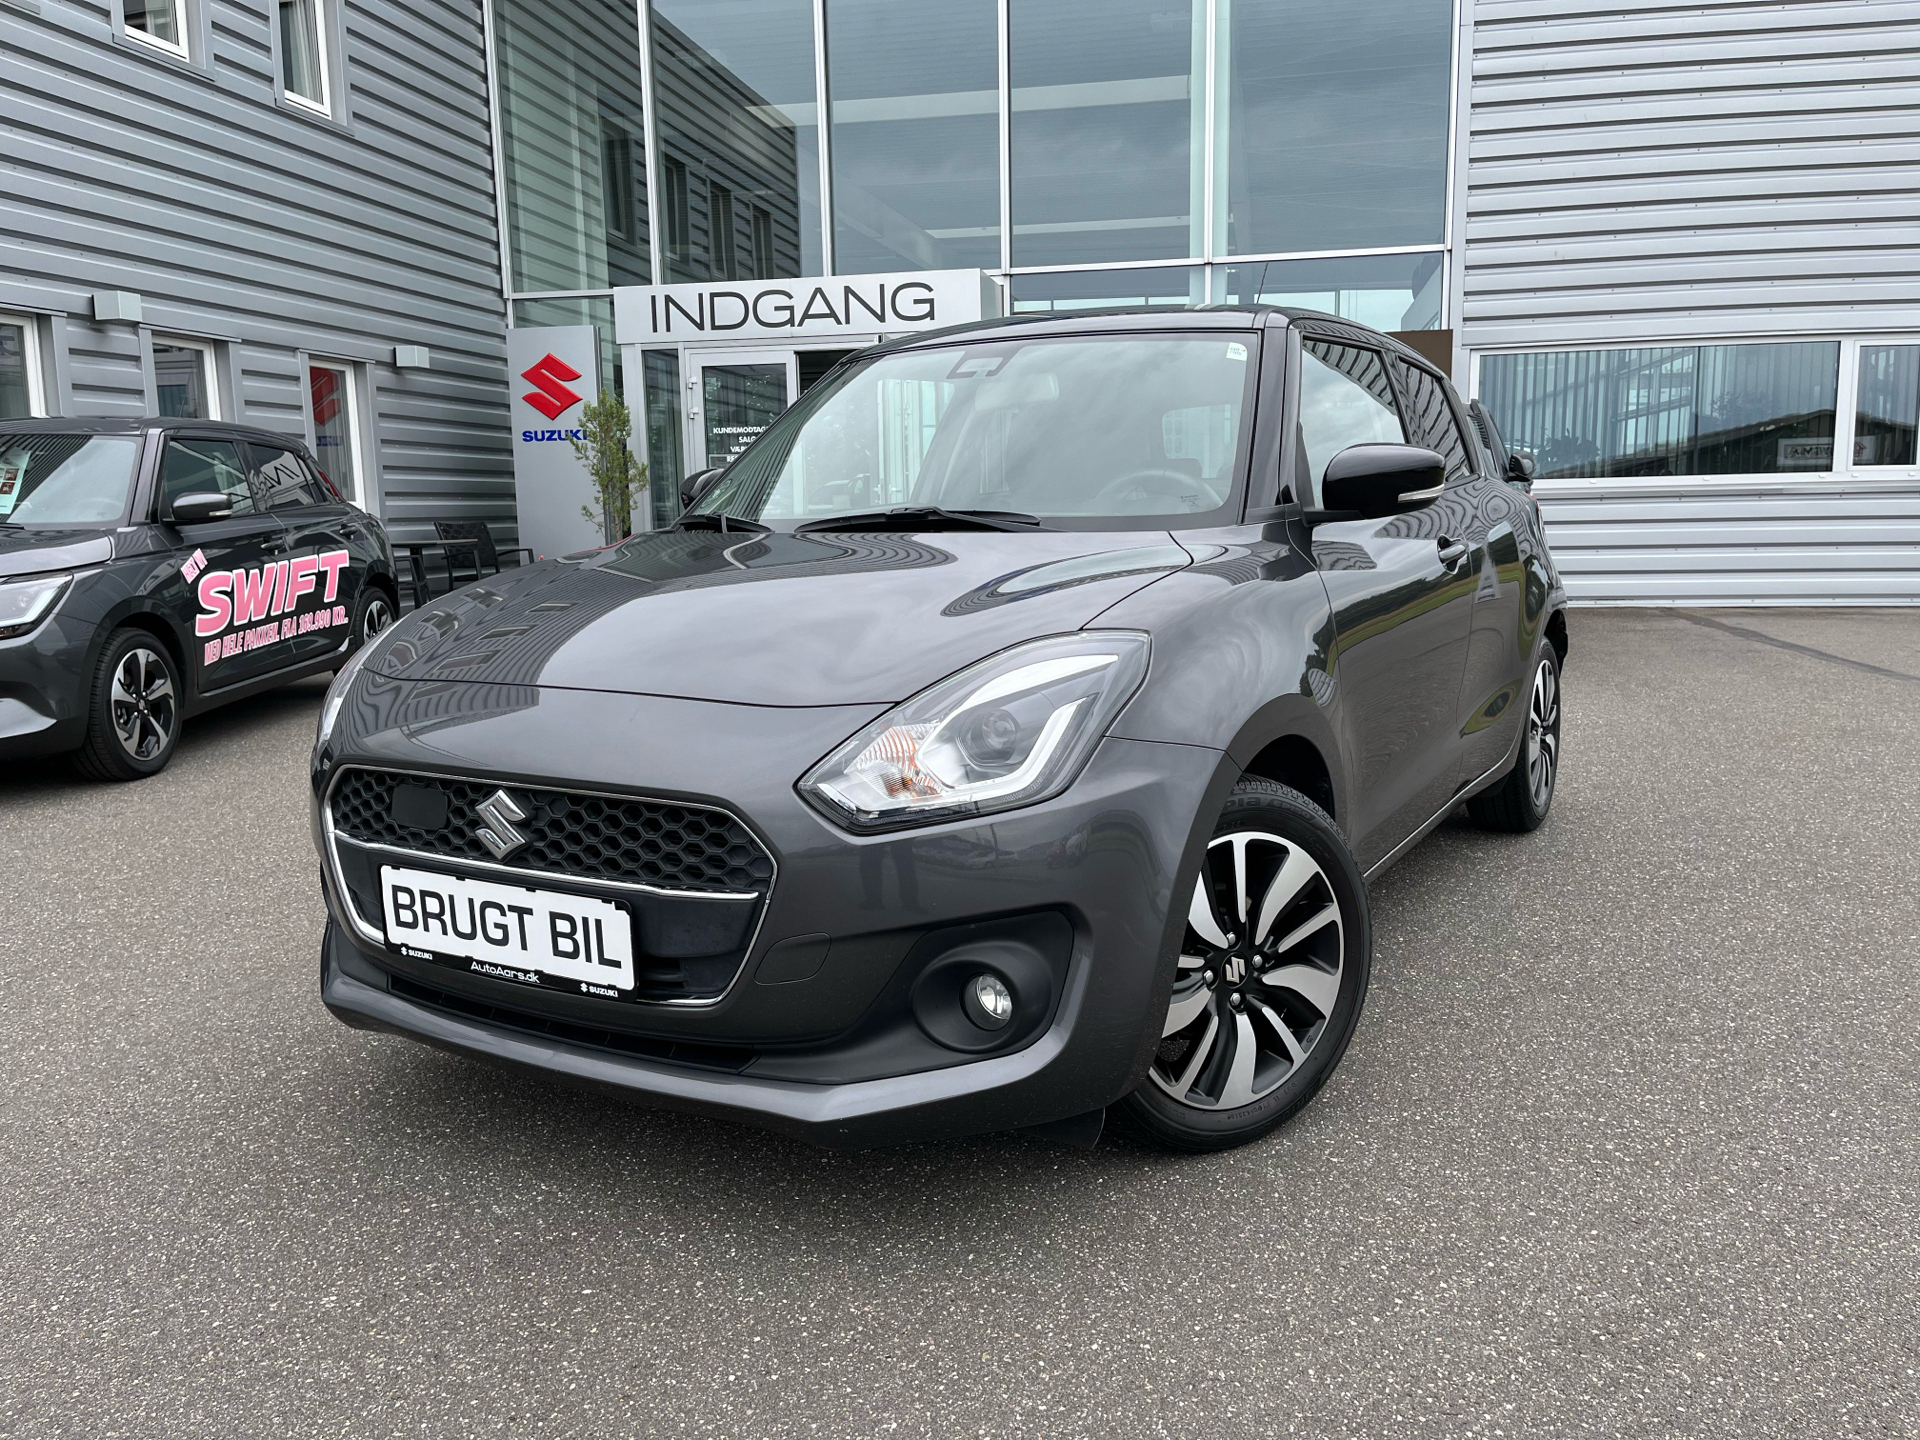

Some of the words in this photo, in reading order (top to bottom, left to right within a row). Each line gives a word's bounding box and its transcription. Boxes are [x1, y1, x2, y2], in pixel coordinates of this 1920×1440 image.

[650, 282, 935, 333] INDGANG
[522, 429, 588, 442] SUZUKI
[713, 426, 769, 434] KUNDEMODTAG
[195, 550, 349, 636] SWIFT
[221, 632, 244, 659] HELE
[281, 615, 297, 640] FRA
[332, 605, 349, 627] KR.
[391, 884, 534, 951] BRUGT
[549, 910, 622, 969] BIL
[408, 949, 433, 961] SUZUKI
[470, 961, 541, 984] AutoAars.dk
[588, 985, 619, 998] SUZUKI
